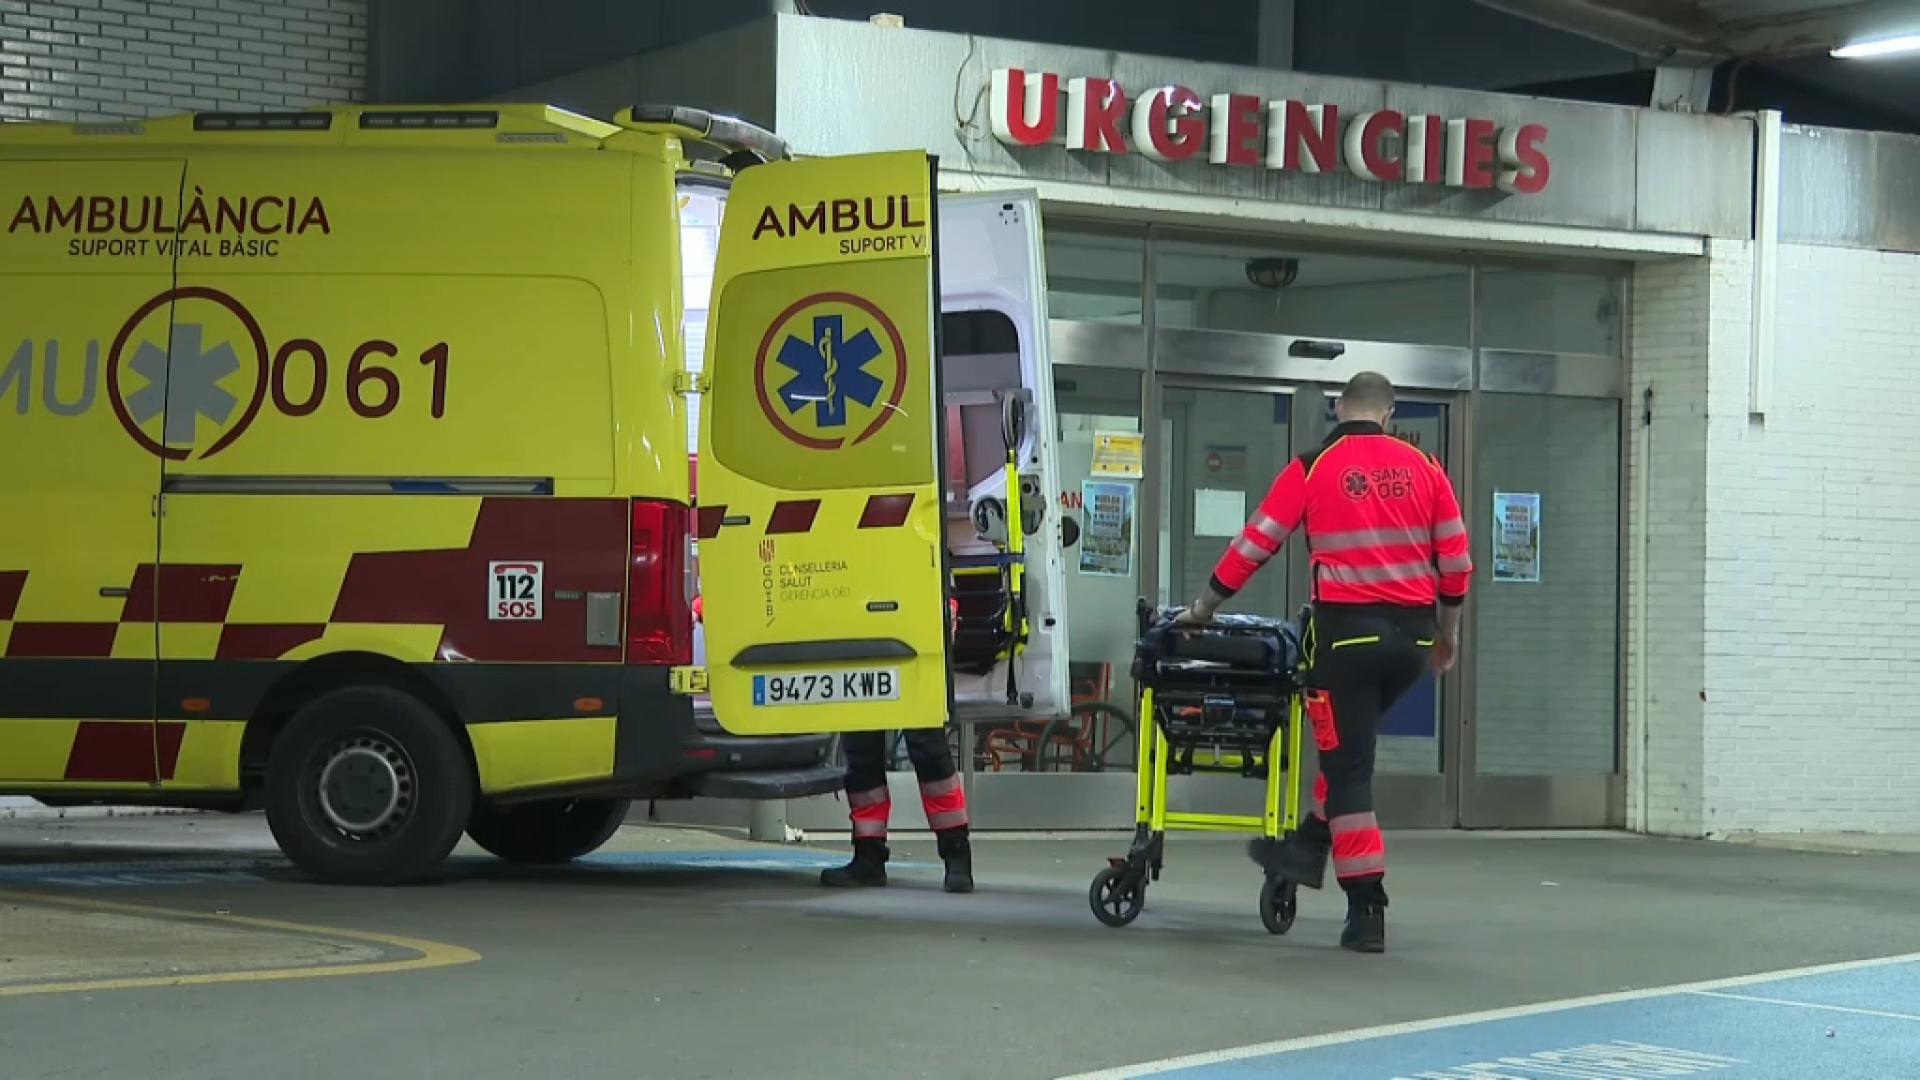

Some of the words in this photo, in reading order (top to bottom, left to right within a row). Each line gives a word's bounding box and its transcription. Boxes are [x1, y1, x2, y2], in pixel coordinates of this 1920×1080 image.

[990, 68, 1550, 194] URGENCIES
[8, 185, 331, 234] AMBULÀNCIA
[751, 194, 925, 241] AMBUL
[68, 239, 149, 257] SUPORT
[156, 239, 212, 257] VITAL
[219, 235, 279, 257] BÀSIC
[839, 235, 906, 255] SUPORT
[271, 338, 450, 419] 061
[1371, 468, 1414, 483] SAMU
[1378, 481, 1413, 499] 061
[496, 574, 535, 600] 112
[779, 576, 812, 589] SALUT
[498, 601, 536, 618] SOS
[769, 675, 834, 702] 9473
[843, 671, 892, 698] KWB
